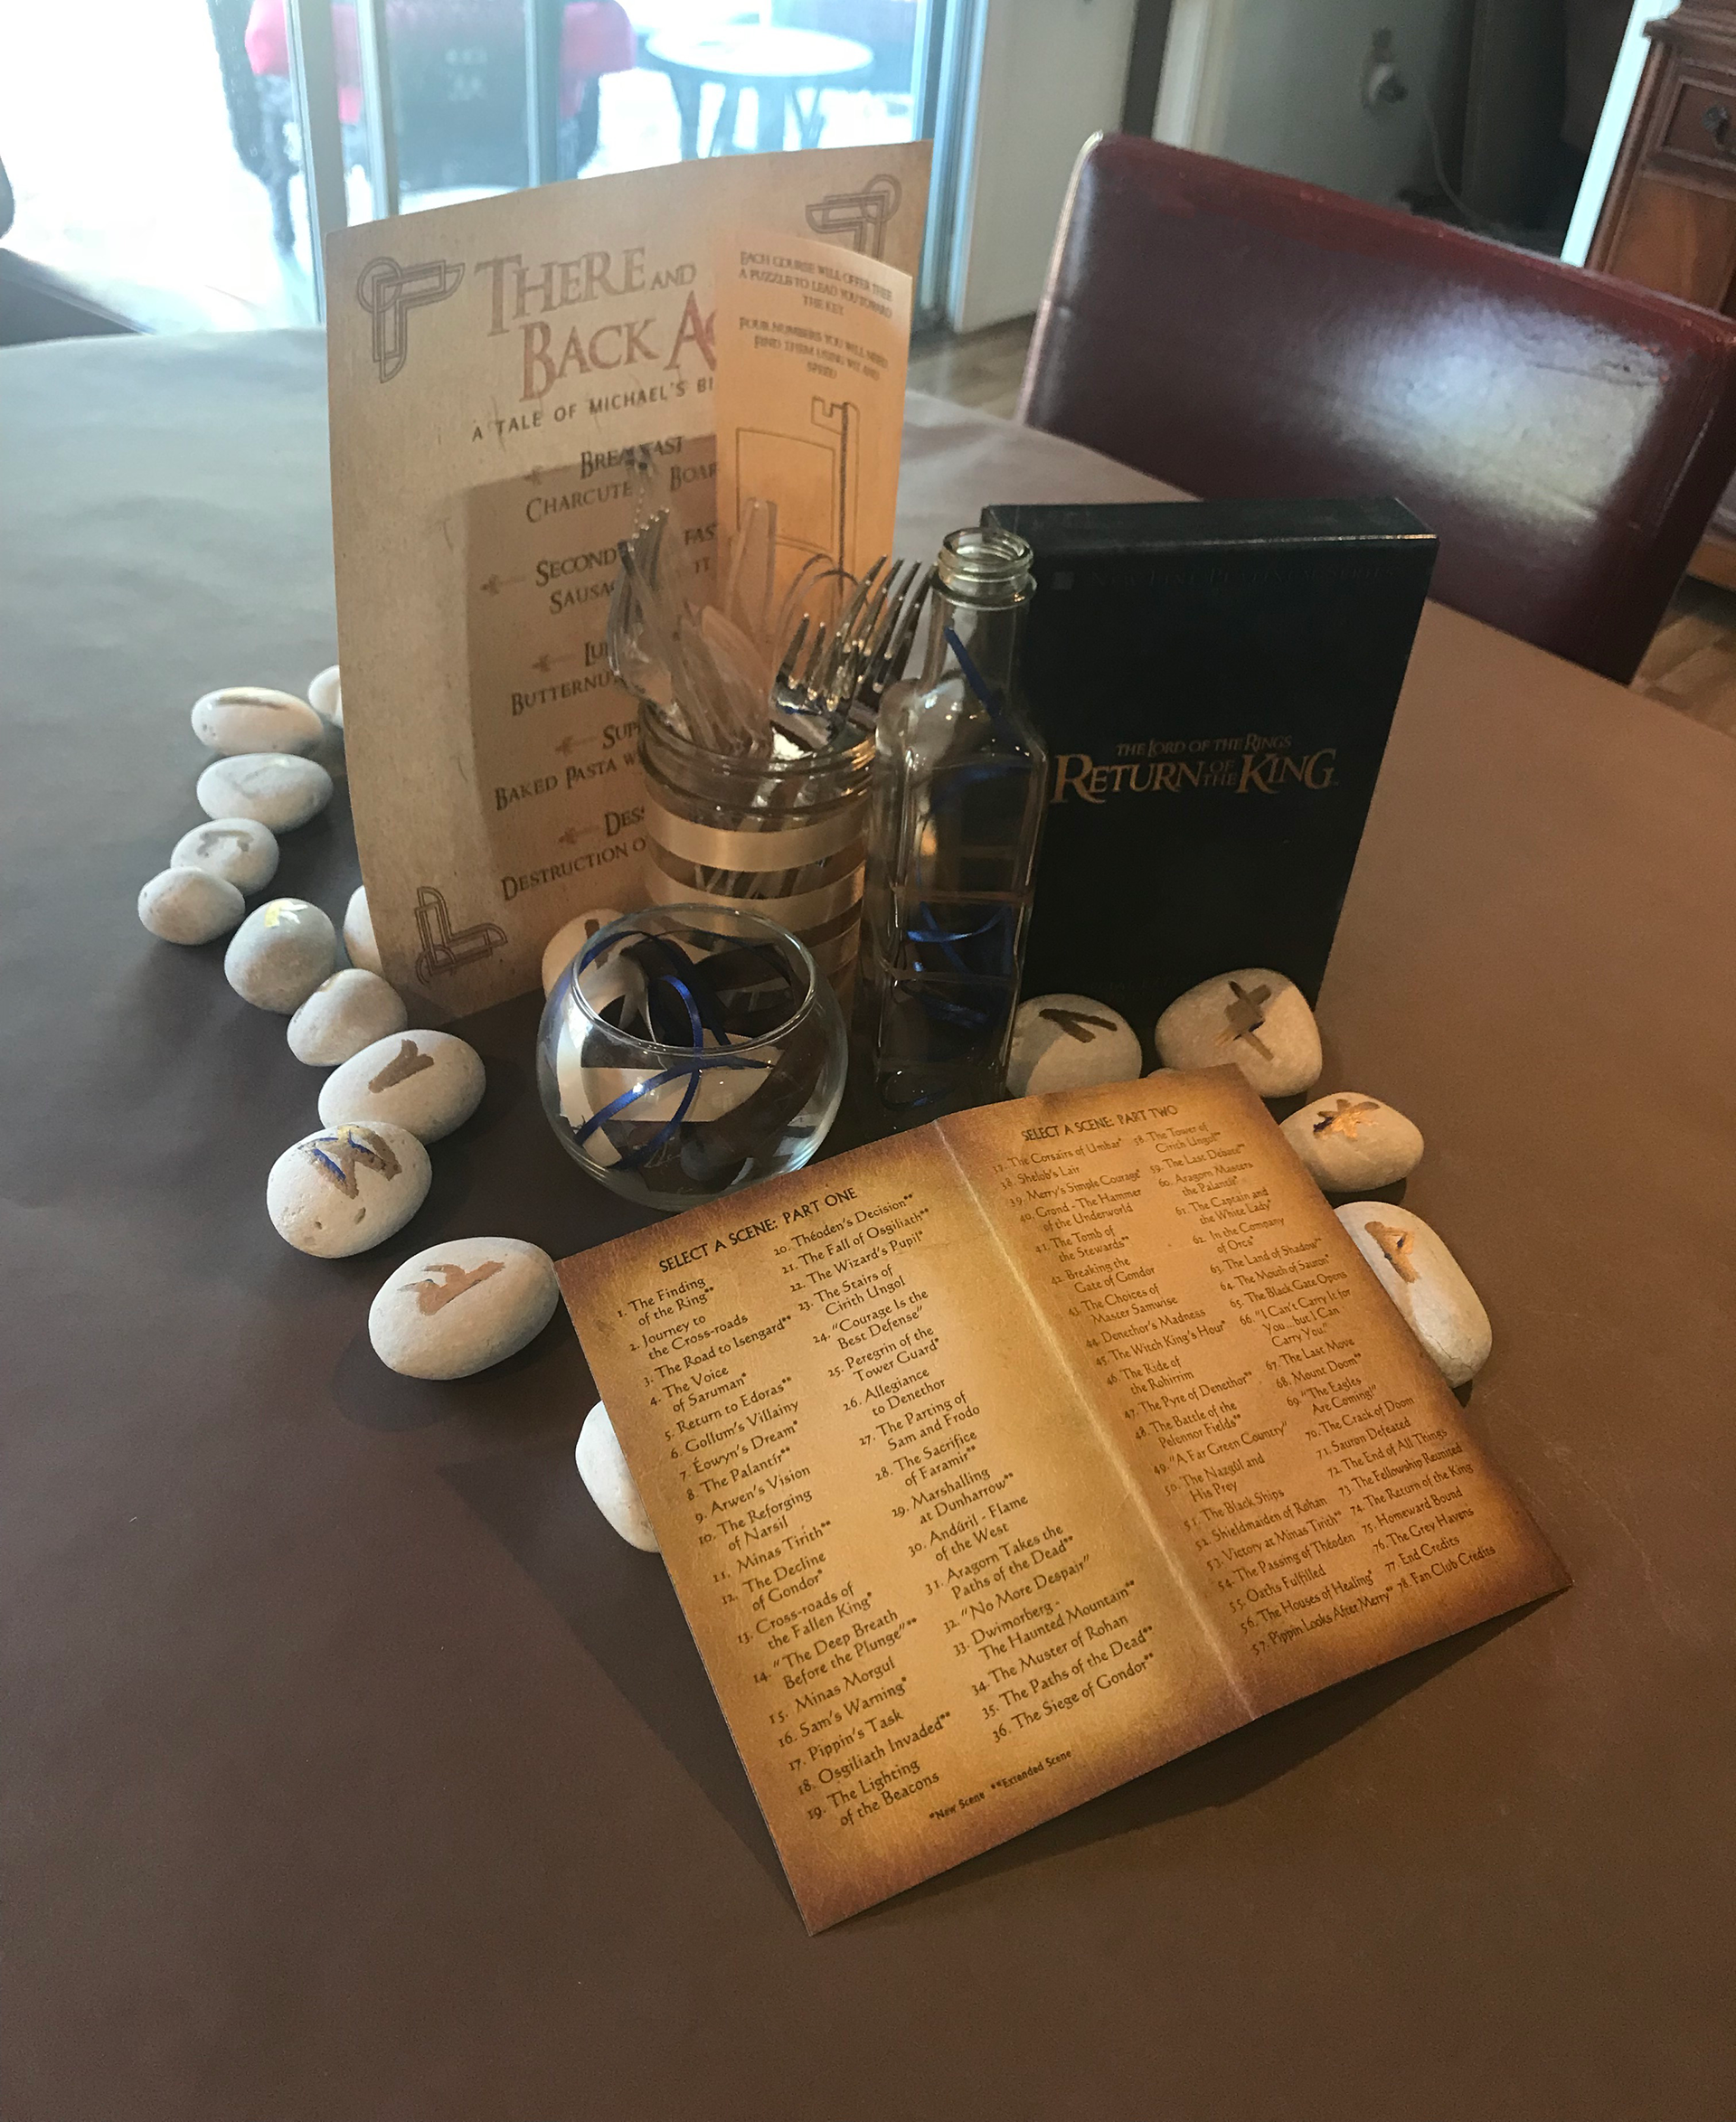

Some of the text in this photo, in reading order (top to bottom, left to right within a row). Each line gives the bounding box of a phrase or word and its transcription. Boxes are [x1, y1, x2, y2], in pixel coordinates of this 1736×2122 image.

[474, 247, 646, 337] THERE
[650, 262, 697, 291] AND
[739, 269, 748, 280] A
[519, 317, 660, 403] BACK
[472, 426, 483, 442] A
[496, 412, 542, 438] TALE
[553, 404, 577, 422] OF
[590, 382, 685, 416] MICHAEL'S
[535, 547, 618, 588] SECOND
[511, 671, 615, 716] BUTTERNU
[1116, 732, 1292, 759] THE LORD OF THE RINGS
[1210, 759, 1235, 772] OF
[495, 758, 617, 811] BAKED PASTA
[1050, 753, 1203, 804] RETURN
[1203, 771, 1237, 787] THE
[1234, 748, 1336, 795] KING
[501, 842, 628, 901] DESTRUCTION
[1021, 1105, 1178, 1142] SELECT A SCENE: PART TWO
[1017, 1168, 1059, 1184] Shelob's
[1058, 1165, 1080, 1176] Lair
[658, 1187, 858, 1274] SELECT A SCENE: PART ONE
[1043, 1202, 1134, 1232] of the Underworld
[825, 1275, 906, 1316] Cirith Ungol
[1073, 1266, 1155, 1293] Gate of Gondor
[1090, 1297, 1178, 1325] Master Samwise
[1099, 1320, 1158, 1344] Denethor's
[1157, 1309, 1206, 1328] Madness
[641, 1321, 690, 1348] Journey
[693, 1315, 706, 1326] to
[648, 1314, 749, 1361] the Cross-roads
[836, 1333, 867, 1350] Best
[1271, 1334, 1302, 1347] Carry
[865, 1369, 929, 1403] Allegiance
[872, 1379, 945, 1417] to Denethor
[1130, 1372, 1194, 1395] the Rohirrim
[684, 1421, 746, 1453] Gollum's
[745, 1401, 798, 1427] Villainy
[887, 1405, 980, 1451] Sam and Frodo
[1330, 1435, 1367, 1453] Sauron
[1364, 1416, 1411, 1440] Defeated
[711, 1484, 766, 1516] Arwen's
[765, 1467, 811, 1489] Vision
[1189, 1481, 1238, 1503] His Prey
[1374, 1496, 1432, 1527] Homeward
[1429, 1485, 1464, 1506] Bound
[728, 1514, 788, 1551] of Narsil
[1211, 1513, 1282, 1542] Shieldmaiden
[1282, 1504, 1295, 1519] of
[1292, 1497, 1328, 1514] Rohan
[935, 1523, 1009, 1561] of the West
[1398, 1548, 1422, 1565] End
[1420, 1536, 1460, 1557] Credits
[1246, 1582, 1283, 1603] Oaths
[1280, 1563, 1327, 1589] Fulfilled
[1409, 1571, 1432, 1585] Fan
[1430, 1558, 1458, 1577] Club
[1458, 1545, 1496, 1566] Credits
[987, 1666, 1018, 1683] The
[1018, 1642, 1068, 1673] Muster
[1071, 1630, 1085, 1648] of
[1084, 1615, 1129, 1641] Rohan
[795, 1685, 842, 1713] Minas
[843, 1655, 896, 1691] Morgul
[807, 1727, 865, 1762] Pippin's
[863, 1708, 904, 1733] Task
[826, 1789, 858, 1808] The
[858, 1759, 920, 1795] Lighting
